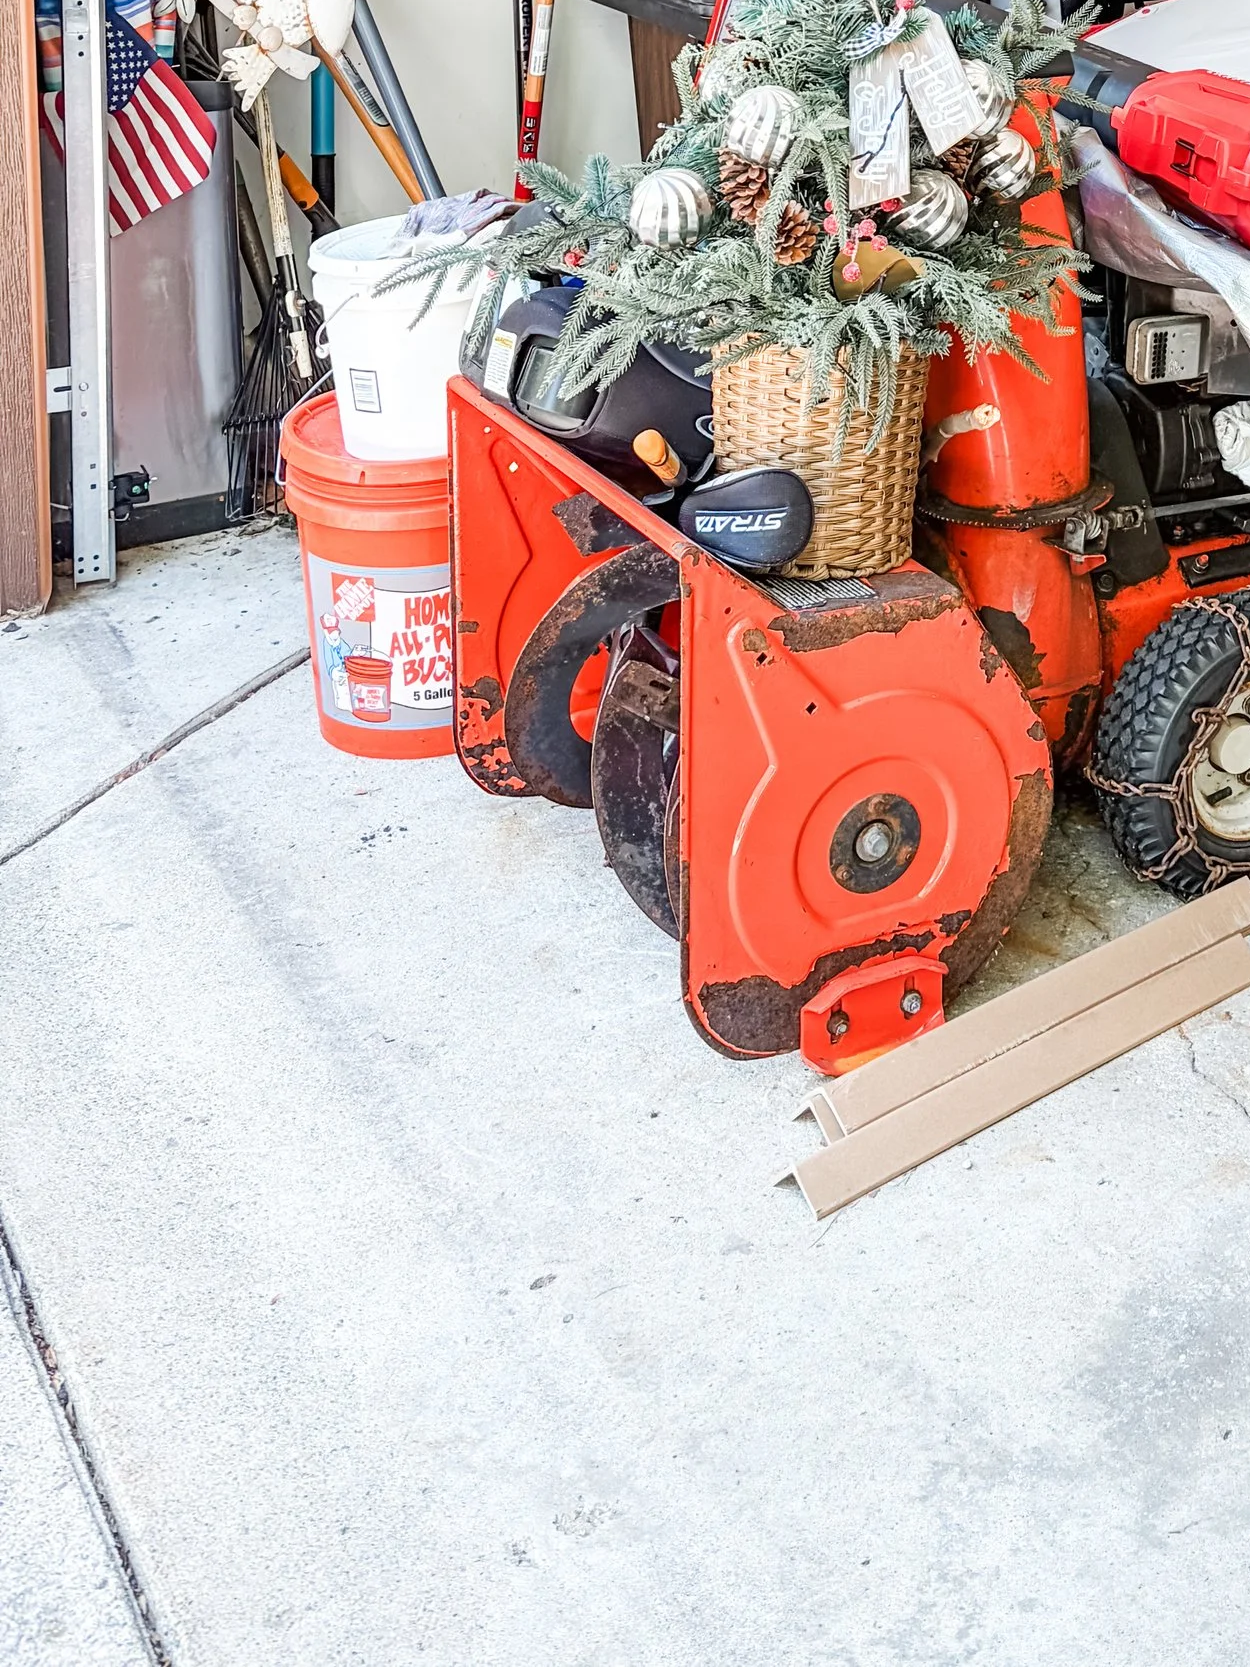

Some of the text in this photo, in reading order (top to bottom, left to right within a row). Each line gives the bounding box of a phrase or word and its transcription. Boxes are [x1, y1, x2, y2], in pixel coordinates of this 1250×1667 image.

[695, 512, 788, 533] STRATA
[334, 577, 375, 620] HOME
[348, 594, 376, 621] DEPOT
[413, 690, 421, 701] 5
